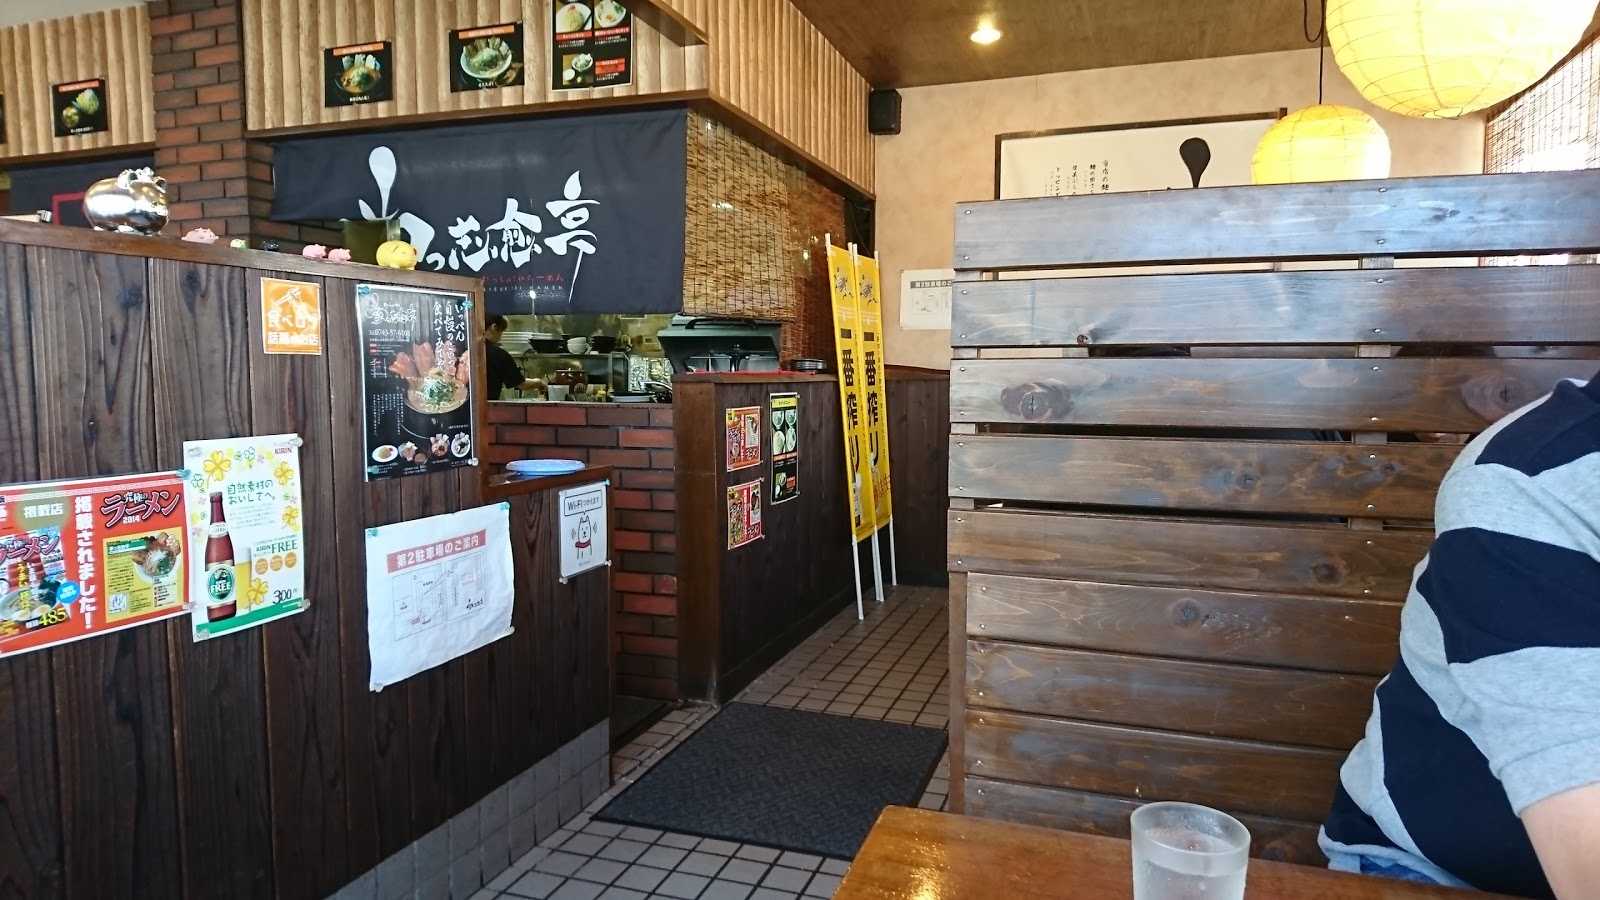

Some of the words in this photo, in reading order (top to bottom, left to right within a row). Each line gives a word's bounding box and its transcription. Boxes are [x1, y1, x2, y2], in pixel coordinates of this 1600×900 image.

[455, 303, 466, 342] いっぺん
[840, 328, 860, 474] 一番搾り
[863, 331, 879, 466] 一番搾り
[227, 479, 274, 495] 自然素材の
[100, 489, 181, 528] ラーメン
[122, 515, 142, 525] 2014
[271, 540, 298, 553] FREE
[210, 581, 232, 593] FREE
[38, 607, 68, 627] 485
